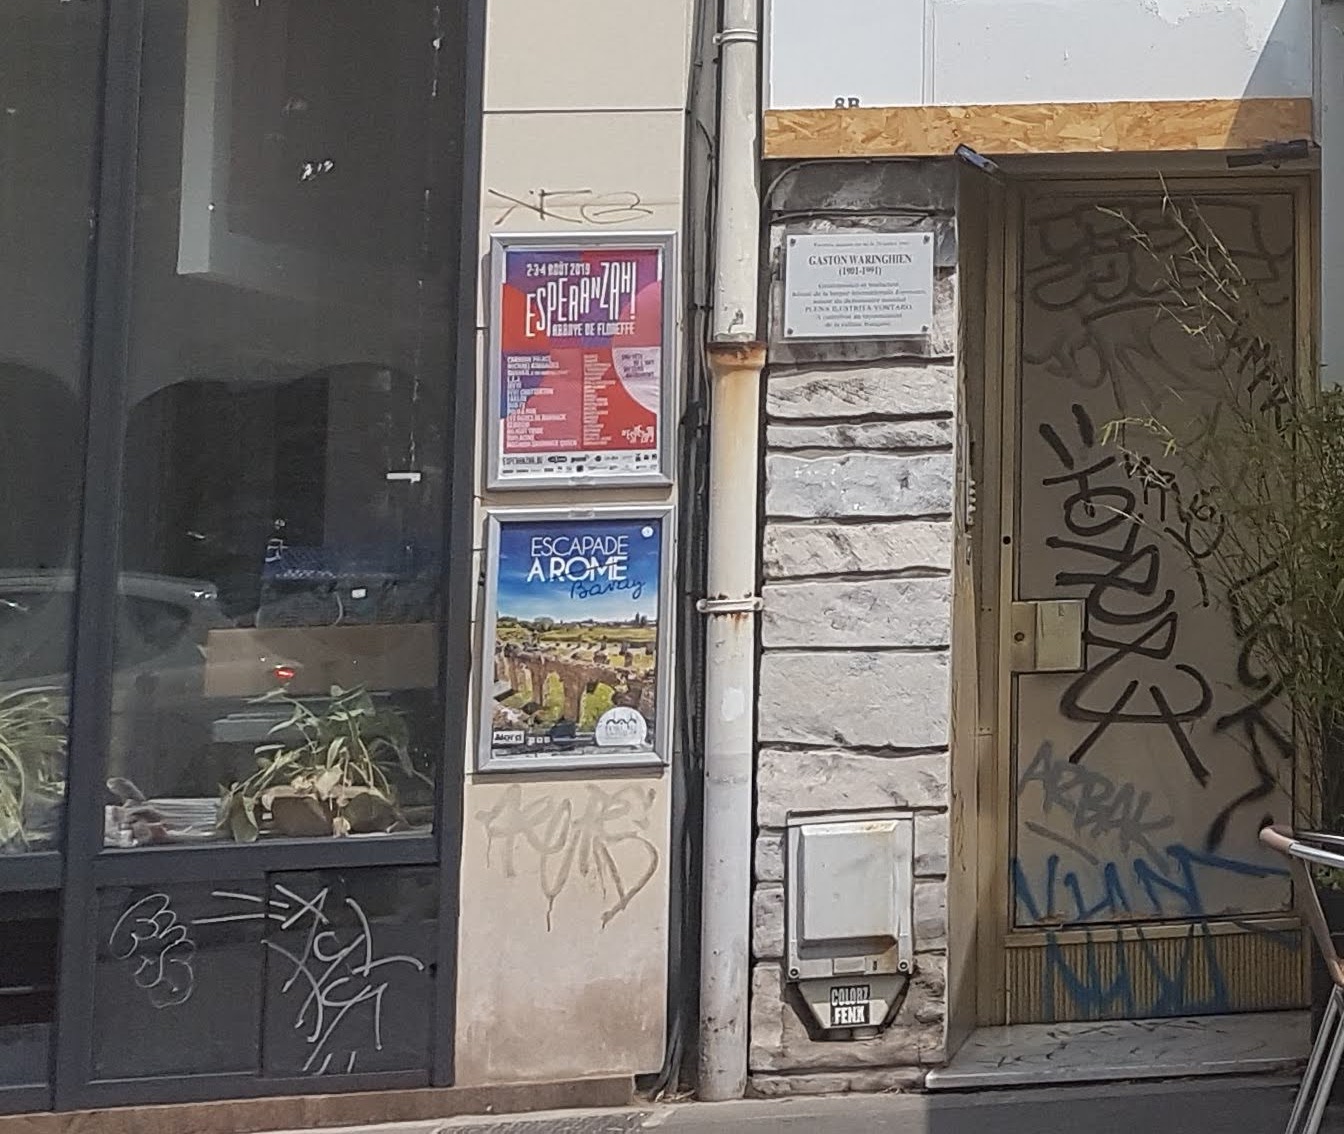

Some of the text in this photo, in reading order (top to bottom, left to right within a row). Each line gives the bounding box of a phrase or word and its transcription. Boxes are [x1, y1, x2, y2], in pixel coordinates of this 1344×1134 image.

[809, 254, 912, 266] GASTON WARINGHIEN
[570, 263, 591, 276] 2019
[531, 536, 629, 556] ESCAPADE
[550, 556, 628, 581] ROME
[832, 987, 868, 1005] COLORZ
